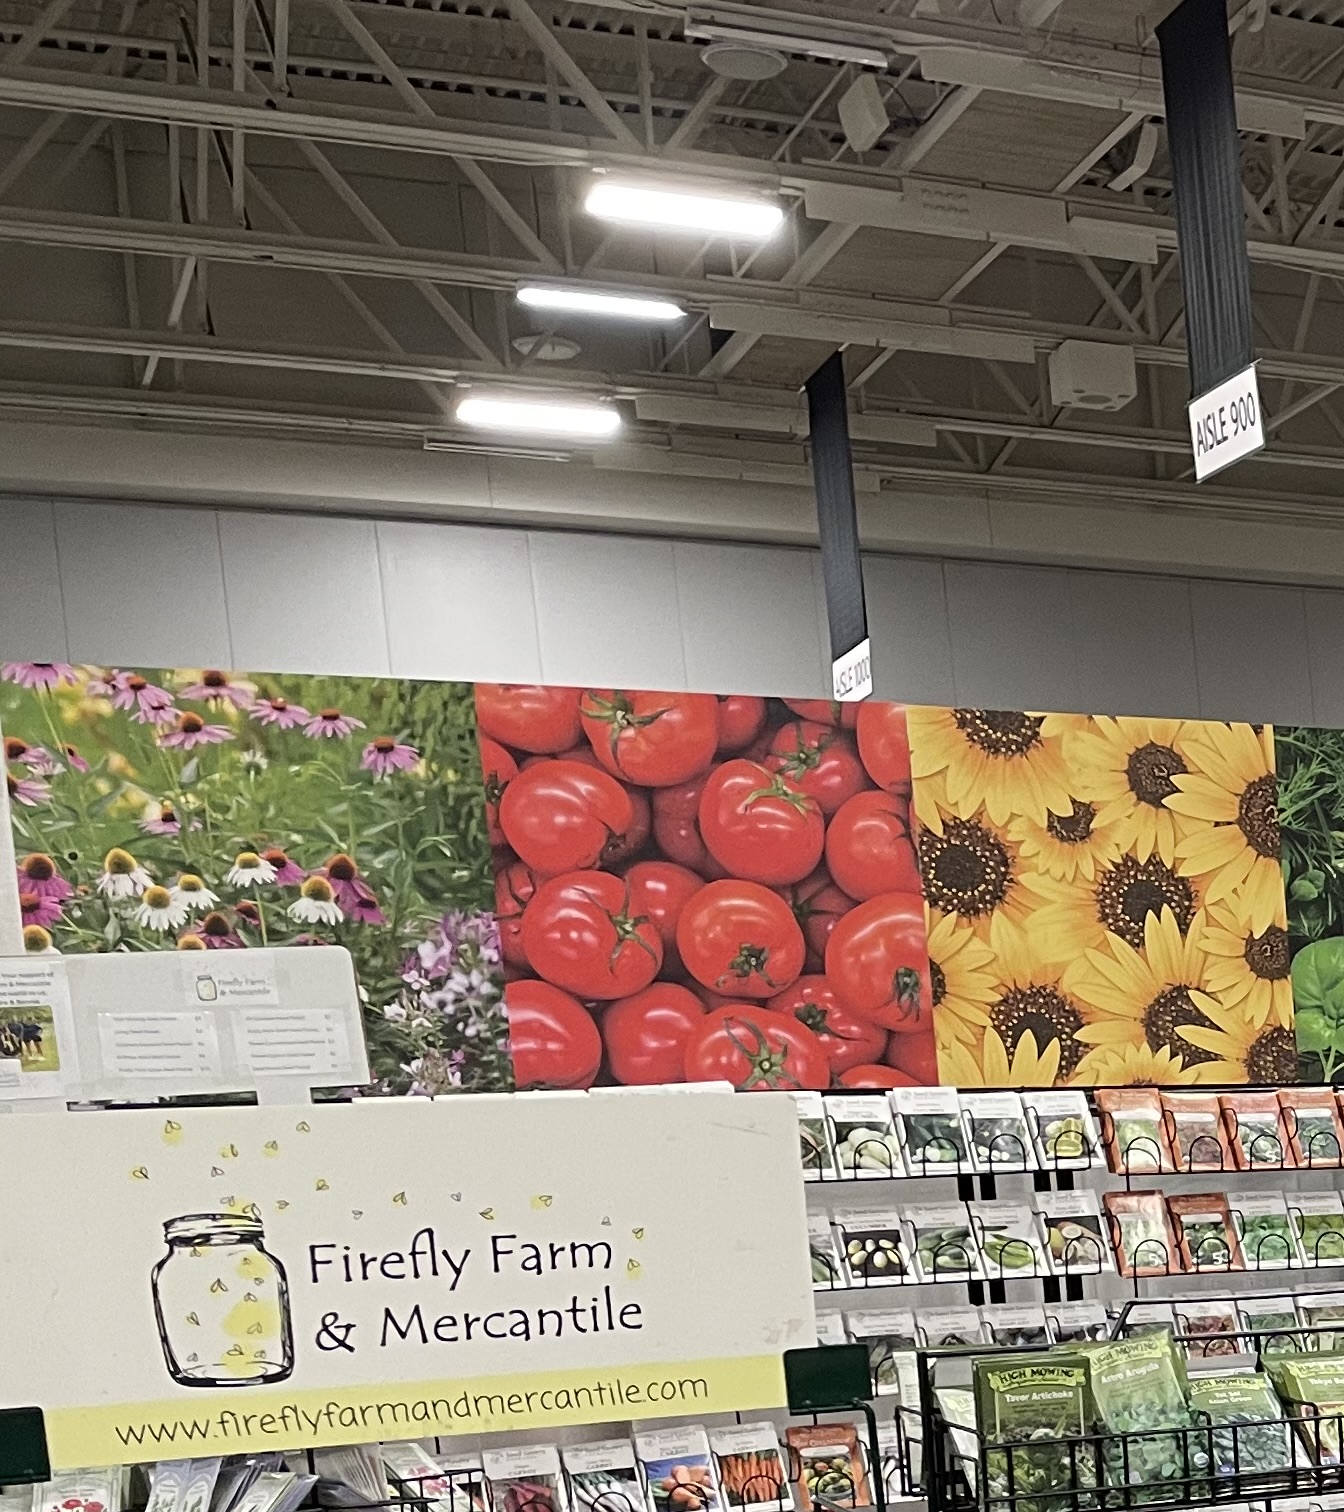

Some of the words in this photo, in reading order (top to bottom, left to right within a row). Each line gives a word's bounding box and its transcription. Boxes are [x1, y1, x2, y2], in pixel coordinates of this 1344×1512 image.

[1197, 406, 1228, 457] AISLE
[1230, 392, 1255, 437] 900
[309, 1228, 470, 1291] Firefly
[490, 1233, 615, 1275] Farm
[313, 1311, 358, 1353] &
[380, 1286, 645, 1348] Mercantile
[1001, 1369, 1027, 1383] HIGH
[1030, 1367, 1075, 1379] MOWING
[114, 1376, 709, 1448] www.fireflyfarmandmercantile.com
